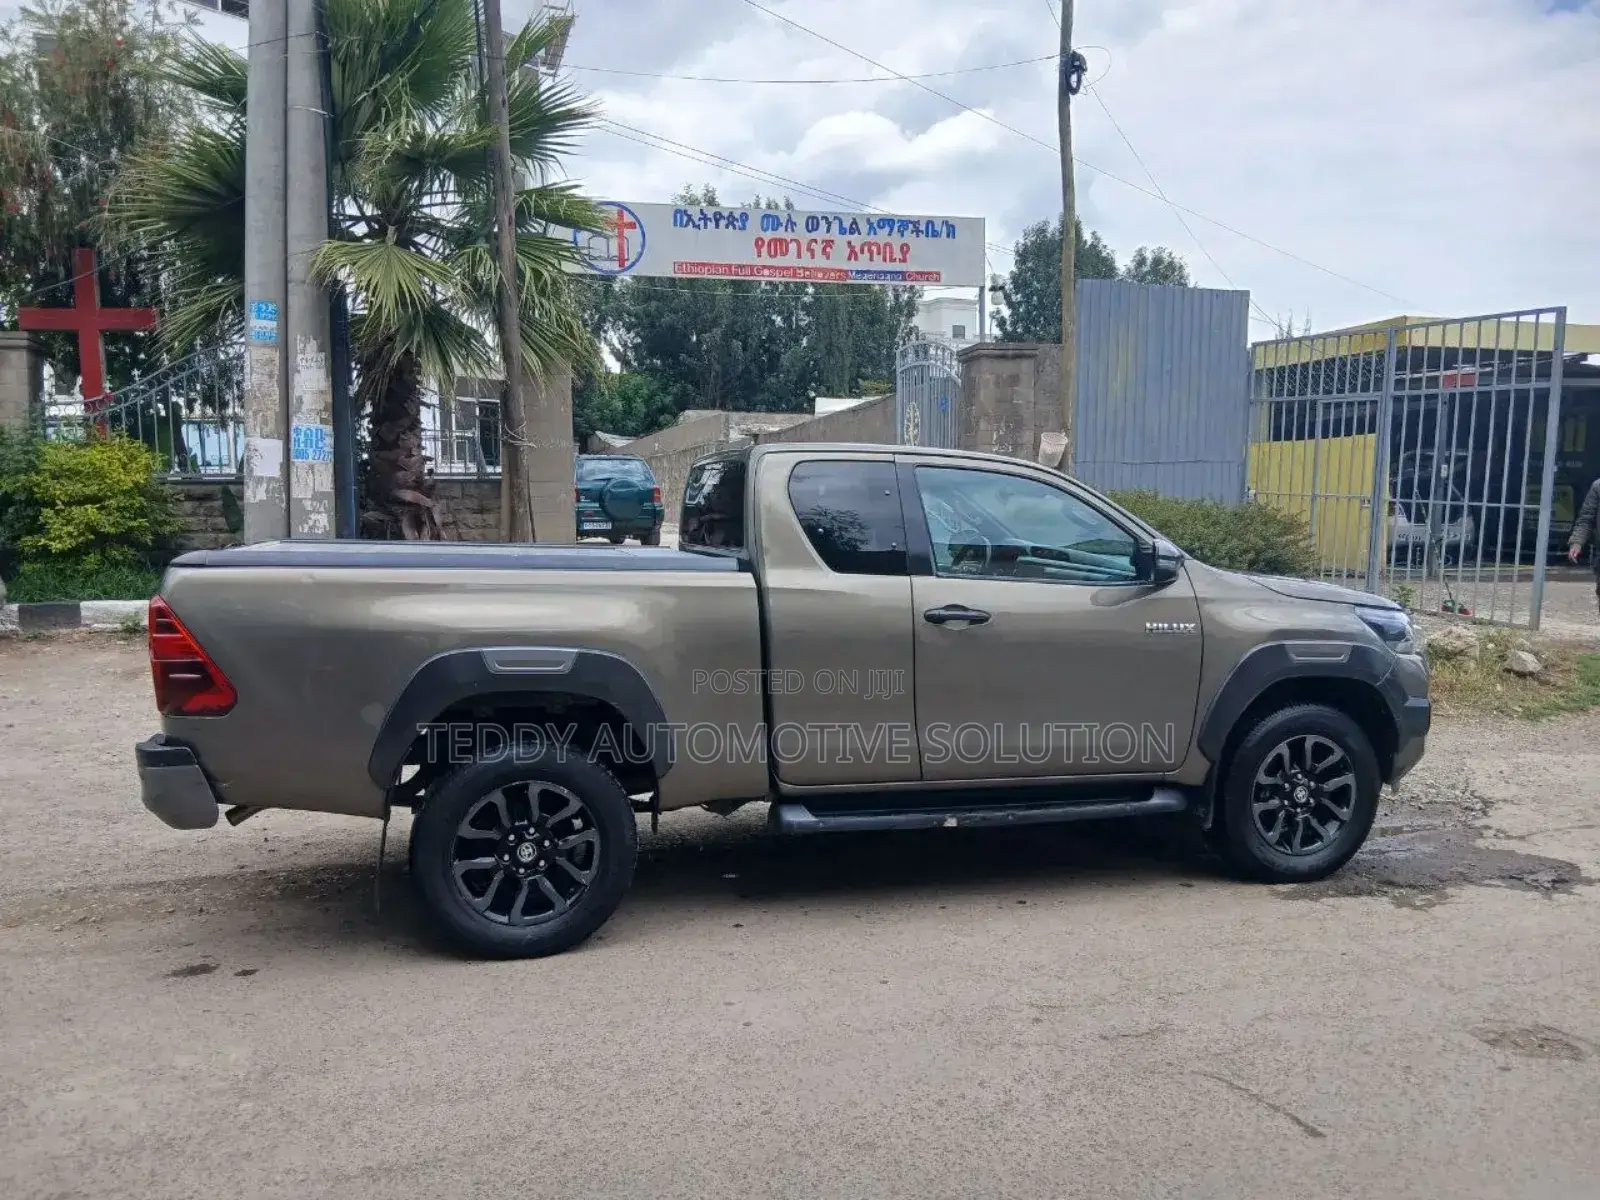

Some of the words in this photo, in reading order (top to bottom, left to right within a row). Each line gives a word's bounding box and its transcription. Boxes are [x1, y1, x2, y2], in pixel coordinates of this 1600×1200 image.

[760, 213, 797, 233] ሙሉ
[805, 215, 861, 236] ወንጌል
[754, 236, 834, 260] የመገናኛ
[675, 262, 729, 276] Ethiopian
[732, 265, 750, 275] Full
[754, 265, 793, 279] Gospel
[906, 271, 940, 282] Church
[1145, 621, 1195, 635] HILUX
